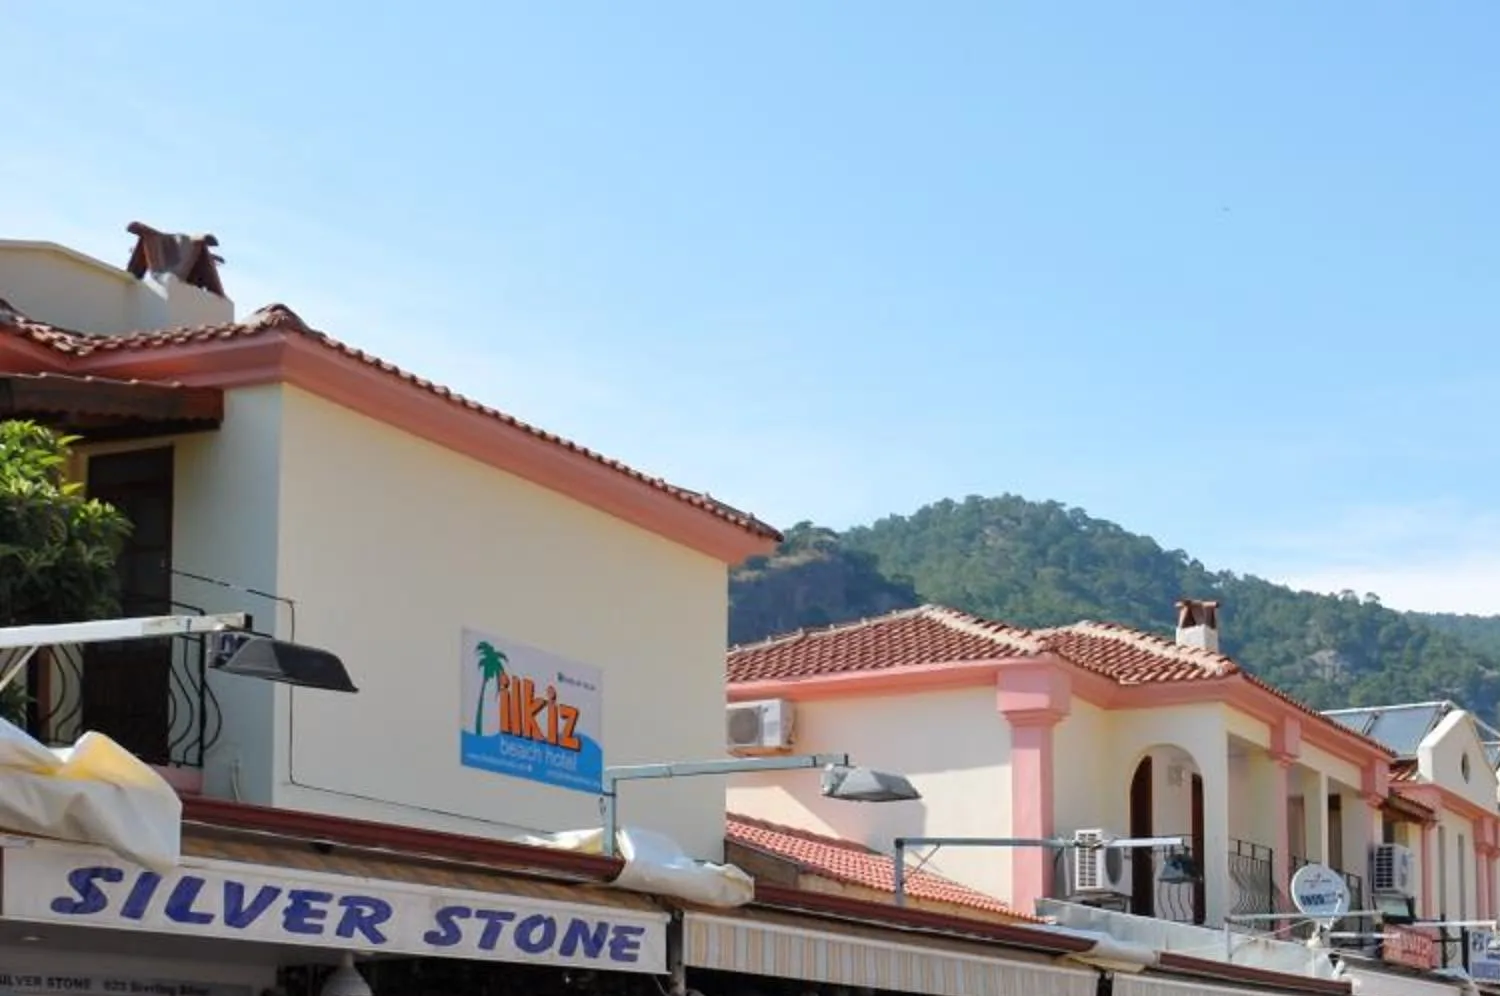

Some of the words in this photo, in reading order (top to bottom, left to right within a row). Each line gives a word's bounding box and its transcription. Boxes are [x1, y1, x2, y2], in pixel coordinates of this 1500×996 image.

[545, 748, 578, 772] hotel
[50, 866, 392, 946] SILVER
[423, 905, 646, 964] STONE
[47, 976, 92, 991] STONE
